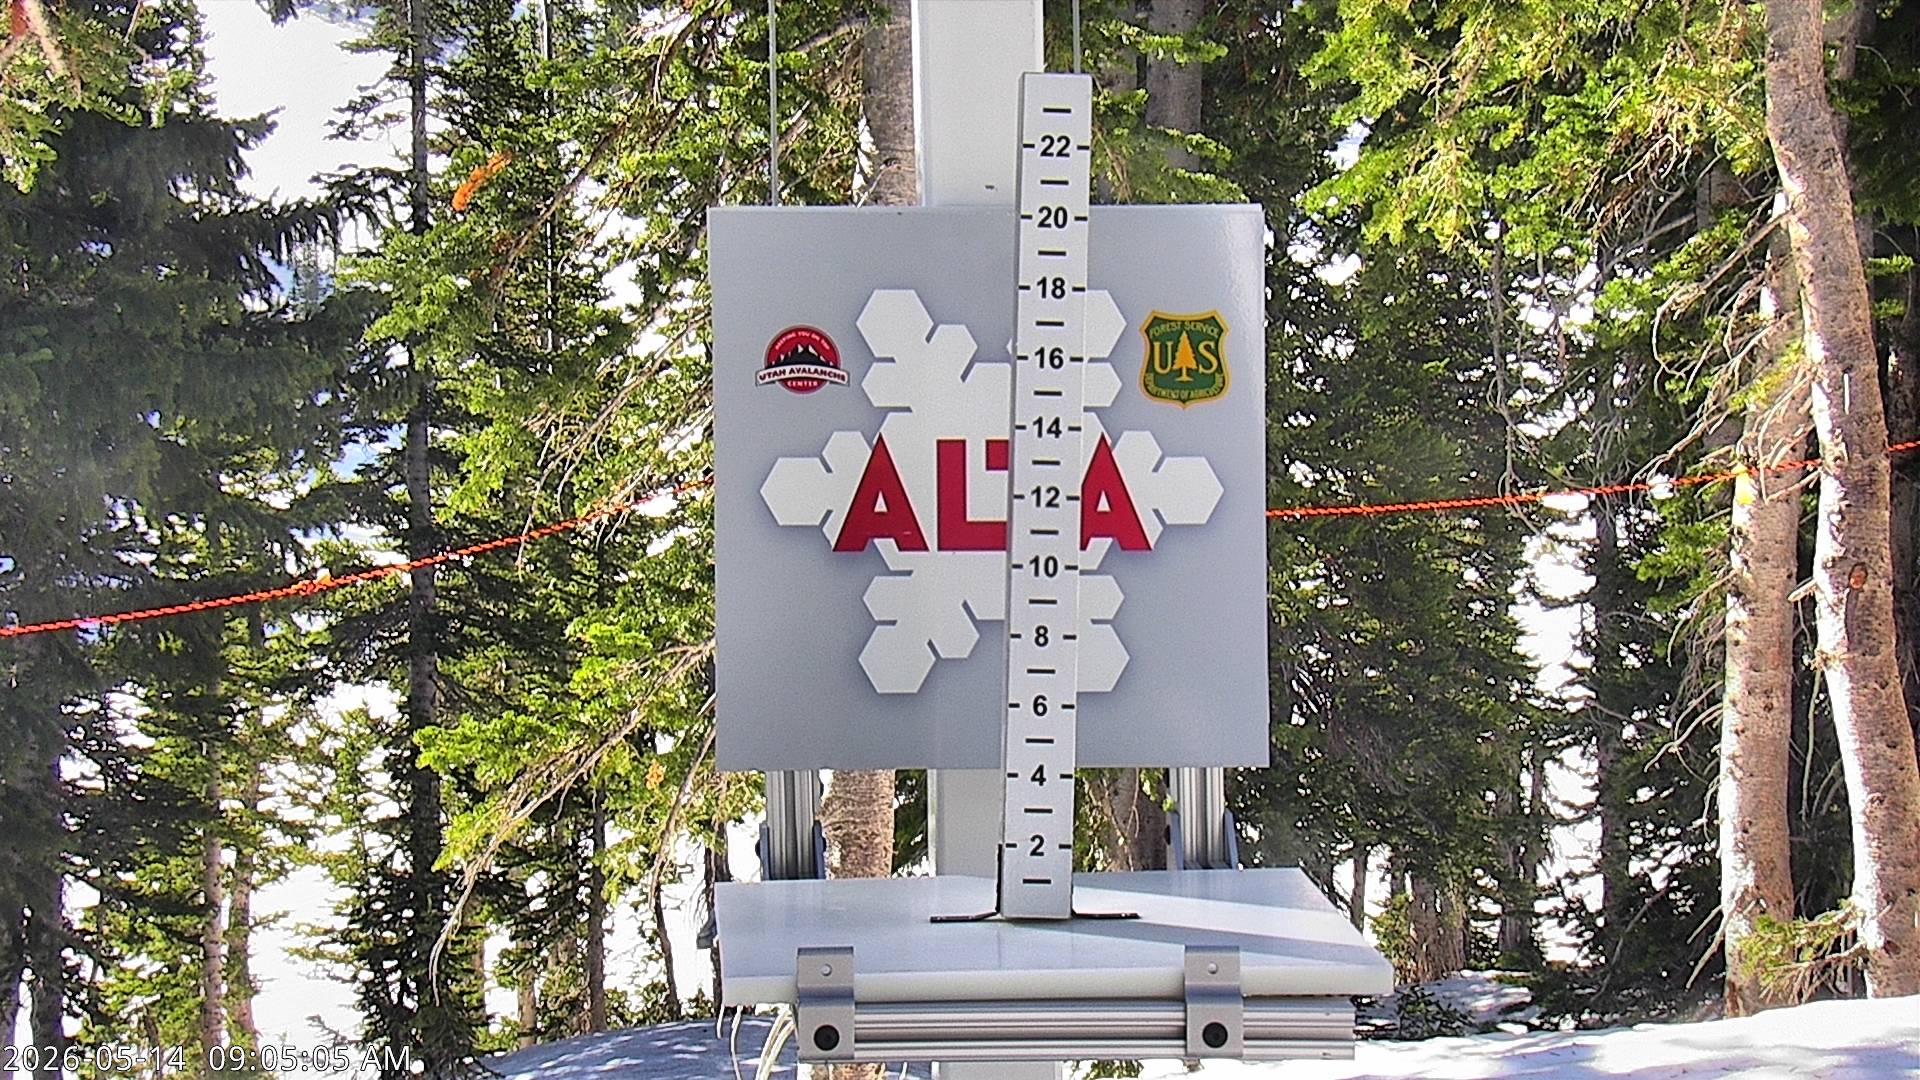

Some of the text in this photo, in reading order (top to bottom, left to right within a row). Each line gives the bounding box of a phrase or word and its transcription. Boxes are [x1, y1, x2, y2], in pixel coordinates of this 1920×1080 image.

[1040, 135, 1071, 157] 22
[1037, 206, 1068, 229] 20
[1036, 277, 1066, 299] 18
[1149, 321, 1181, 339] FOREST
[1034, 347, 1064, 369] 16
[759, 367, 846, 382] UTAH AVALANCHE
[1032, 417, 1062, 438] 14
[1031, 486, 1060, 508] 12
[1029, 556, 1059, 578] 10
[1034, 626, 1049, 648] 8
[1033, 695, 1048, 717] 6
[1030, 765, 1047, 787] 4
[1029, 834, 1045, 857] 2
